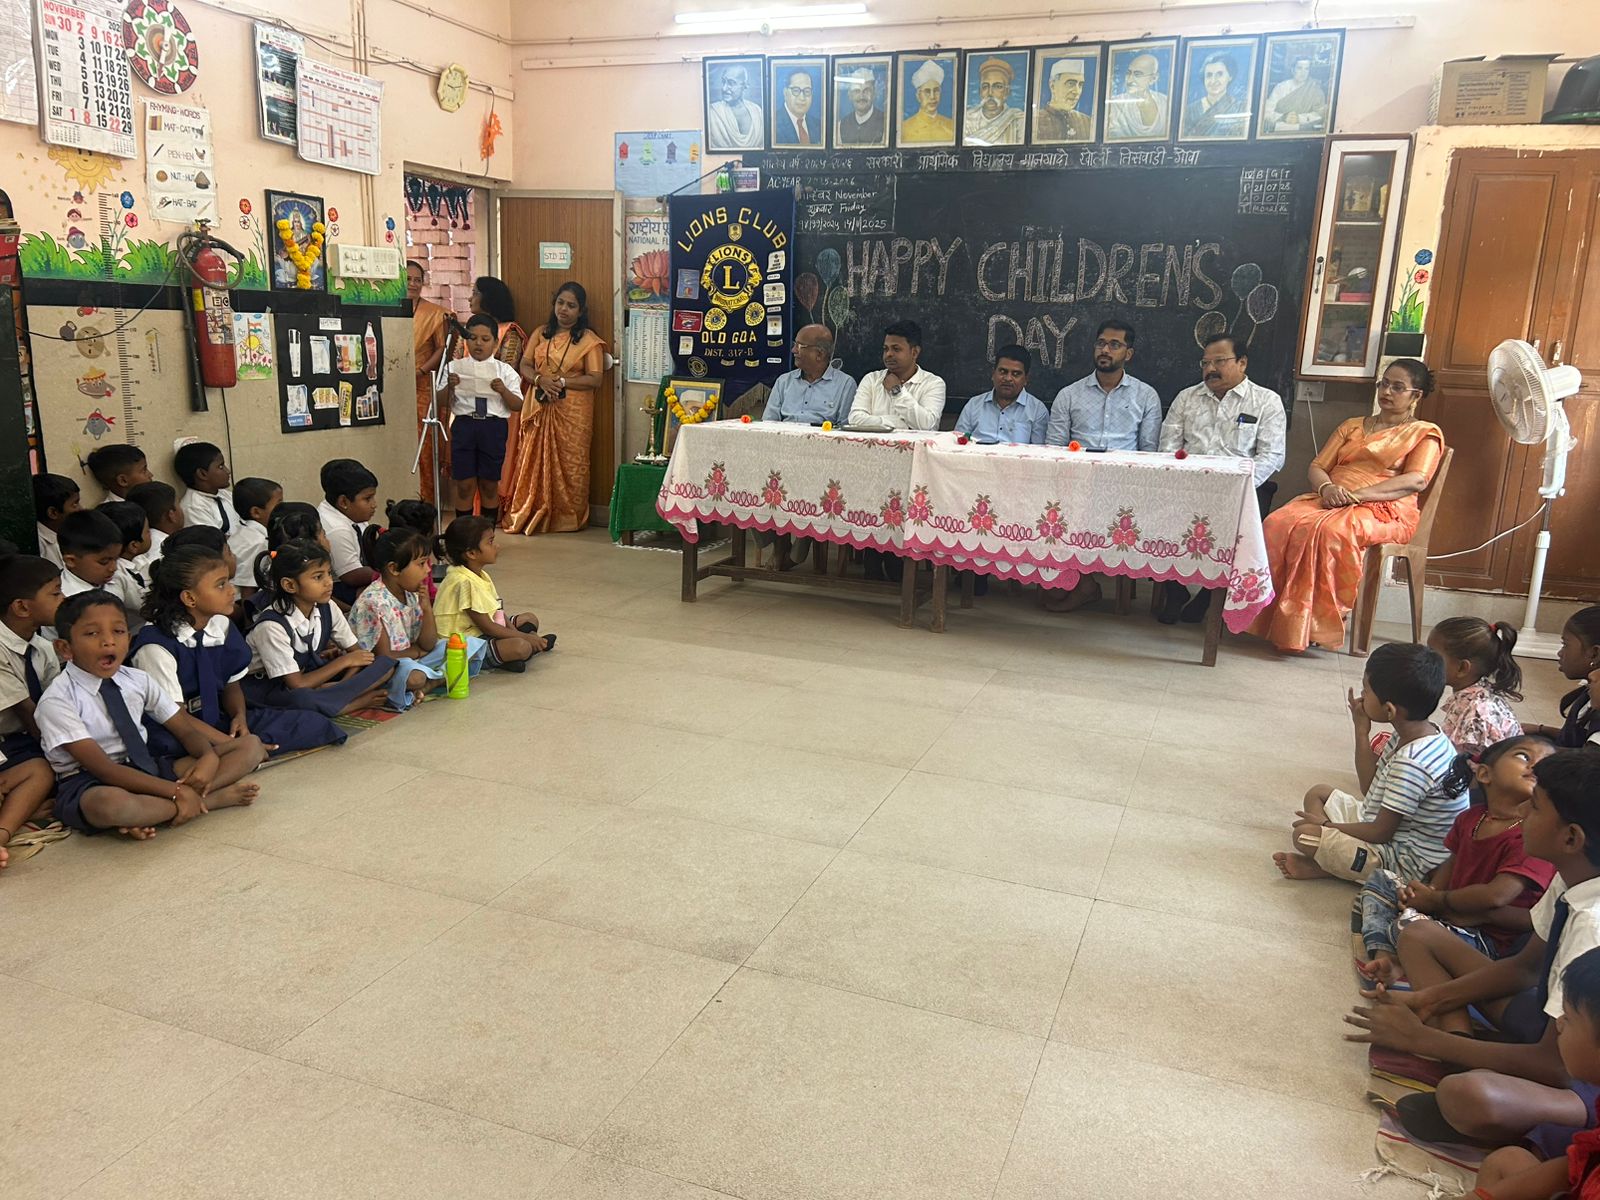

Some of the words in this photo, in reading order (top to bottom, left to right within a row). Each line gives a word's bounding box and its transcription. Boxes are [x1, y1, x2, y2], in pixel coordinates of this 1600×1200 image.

[43, 1, 86, 19] NOVEMBER
[44, 14, 56, 26] SUN
[57, 16, 72, 32] 30
[77, 22, 84, 35] 2
[91, 26, 98, 39] 9
[102, 30, 112, 44] 16
[108, 21, 121, 32] 202
[45, 29, 58, 41] MON
[78, 36, 85, 50] 3
[90, 41, 101, 55] 10
[104, 45, 112, 58] 17
[115, 48, 127, 62] 24
[47, 44, 59, 56] TUE
[80, 52, 86, 65] 4
[92, 56, 102, 70] 11
[105, 59, 114, 73] 18
[116, 63, 128, 77] 25
[48, 60, 61, 72] WED
[81, 66, 87, 80] 5
[93, 70, 104, 84] 12
[106, 74, 116, 88] 19
[118, 77, 129, 91] 26
[50, 75, 62, 87] THU
[82, 81, 89, 95] 6
[94, 84, 105, 99] 13
[107, 88, 118, 102] 20
[120, 91, 130, 106] 27
[51, 90, 62, 101] FRI
[83, 96, 89, 109] 7
[95, 99, 106, 113] 14
[108, 103, 119, 117] 21
[120, 106, 132, 120] 28
[52, 105, 63, 117] SAT
[70, 107, 76, 121] 1
[84, 111, 91, 125] 8
[96, 114, 107, 128] 15
[109, 117, 121, 131] 22
[121, 120, 132, 134] 29
[866, 152, 903, 168] सरकारी
[918, 151, 959, 170] प्राथमिक
[1256, 170, 1264, 179] B
[1271, 169, 1278, 178] G
[836, 187, 878, 200] November
[840, 202, 866, 215] Friday
[628, 217, 661, 236] राष्ट्रीय
[677, 206, 728, 252] LIONS
[738, 207, 787, 249] CLUB
[628, 236, 660, 245] NATIONAL
[712, 246, 750, 261] LIONS
[723, 265, 740, 290] L
[845, 236, 963, 298] HAPPY
[976, 237, 1223, 310] CHILDREN'S
[701, 331, 726, 344] OLD
[731, 330, 757, 344] GOA
[986, 313, 1077, 369] DAY
[728, 347, 754, 357] 317-B
